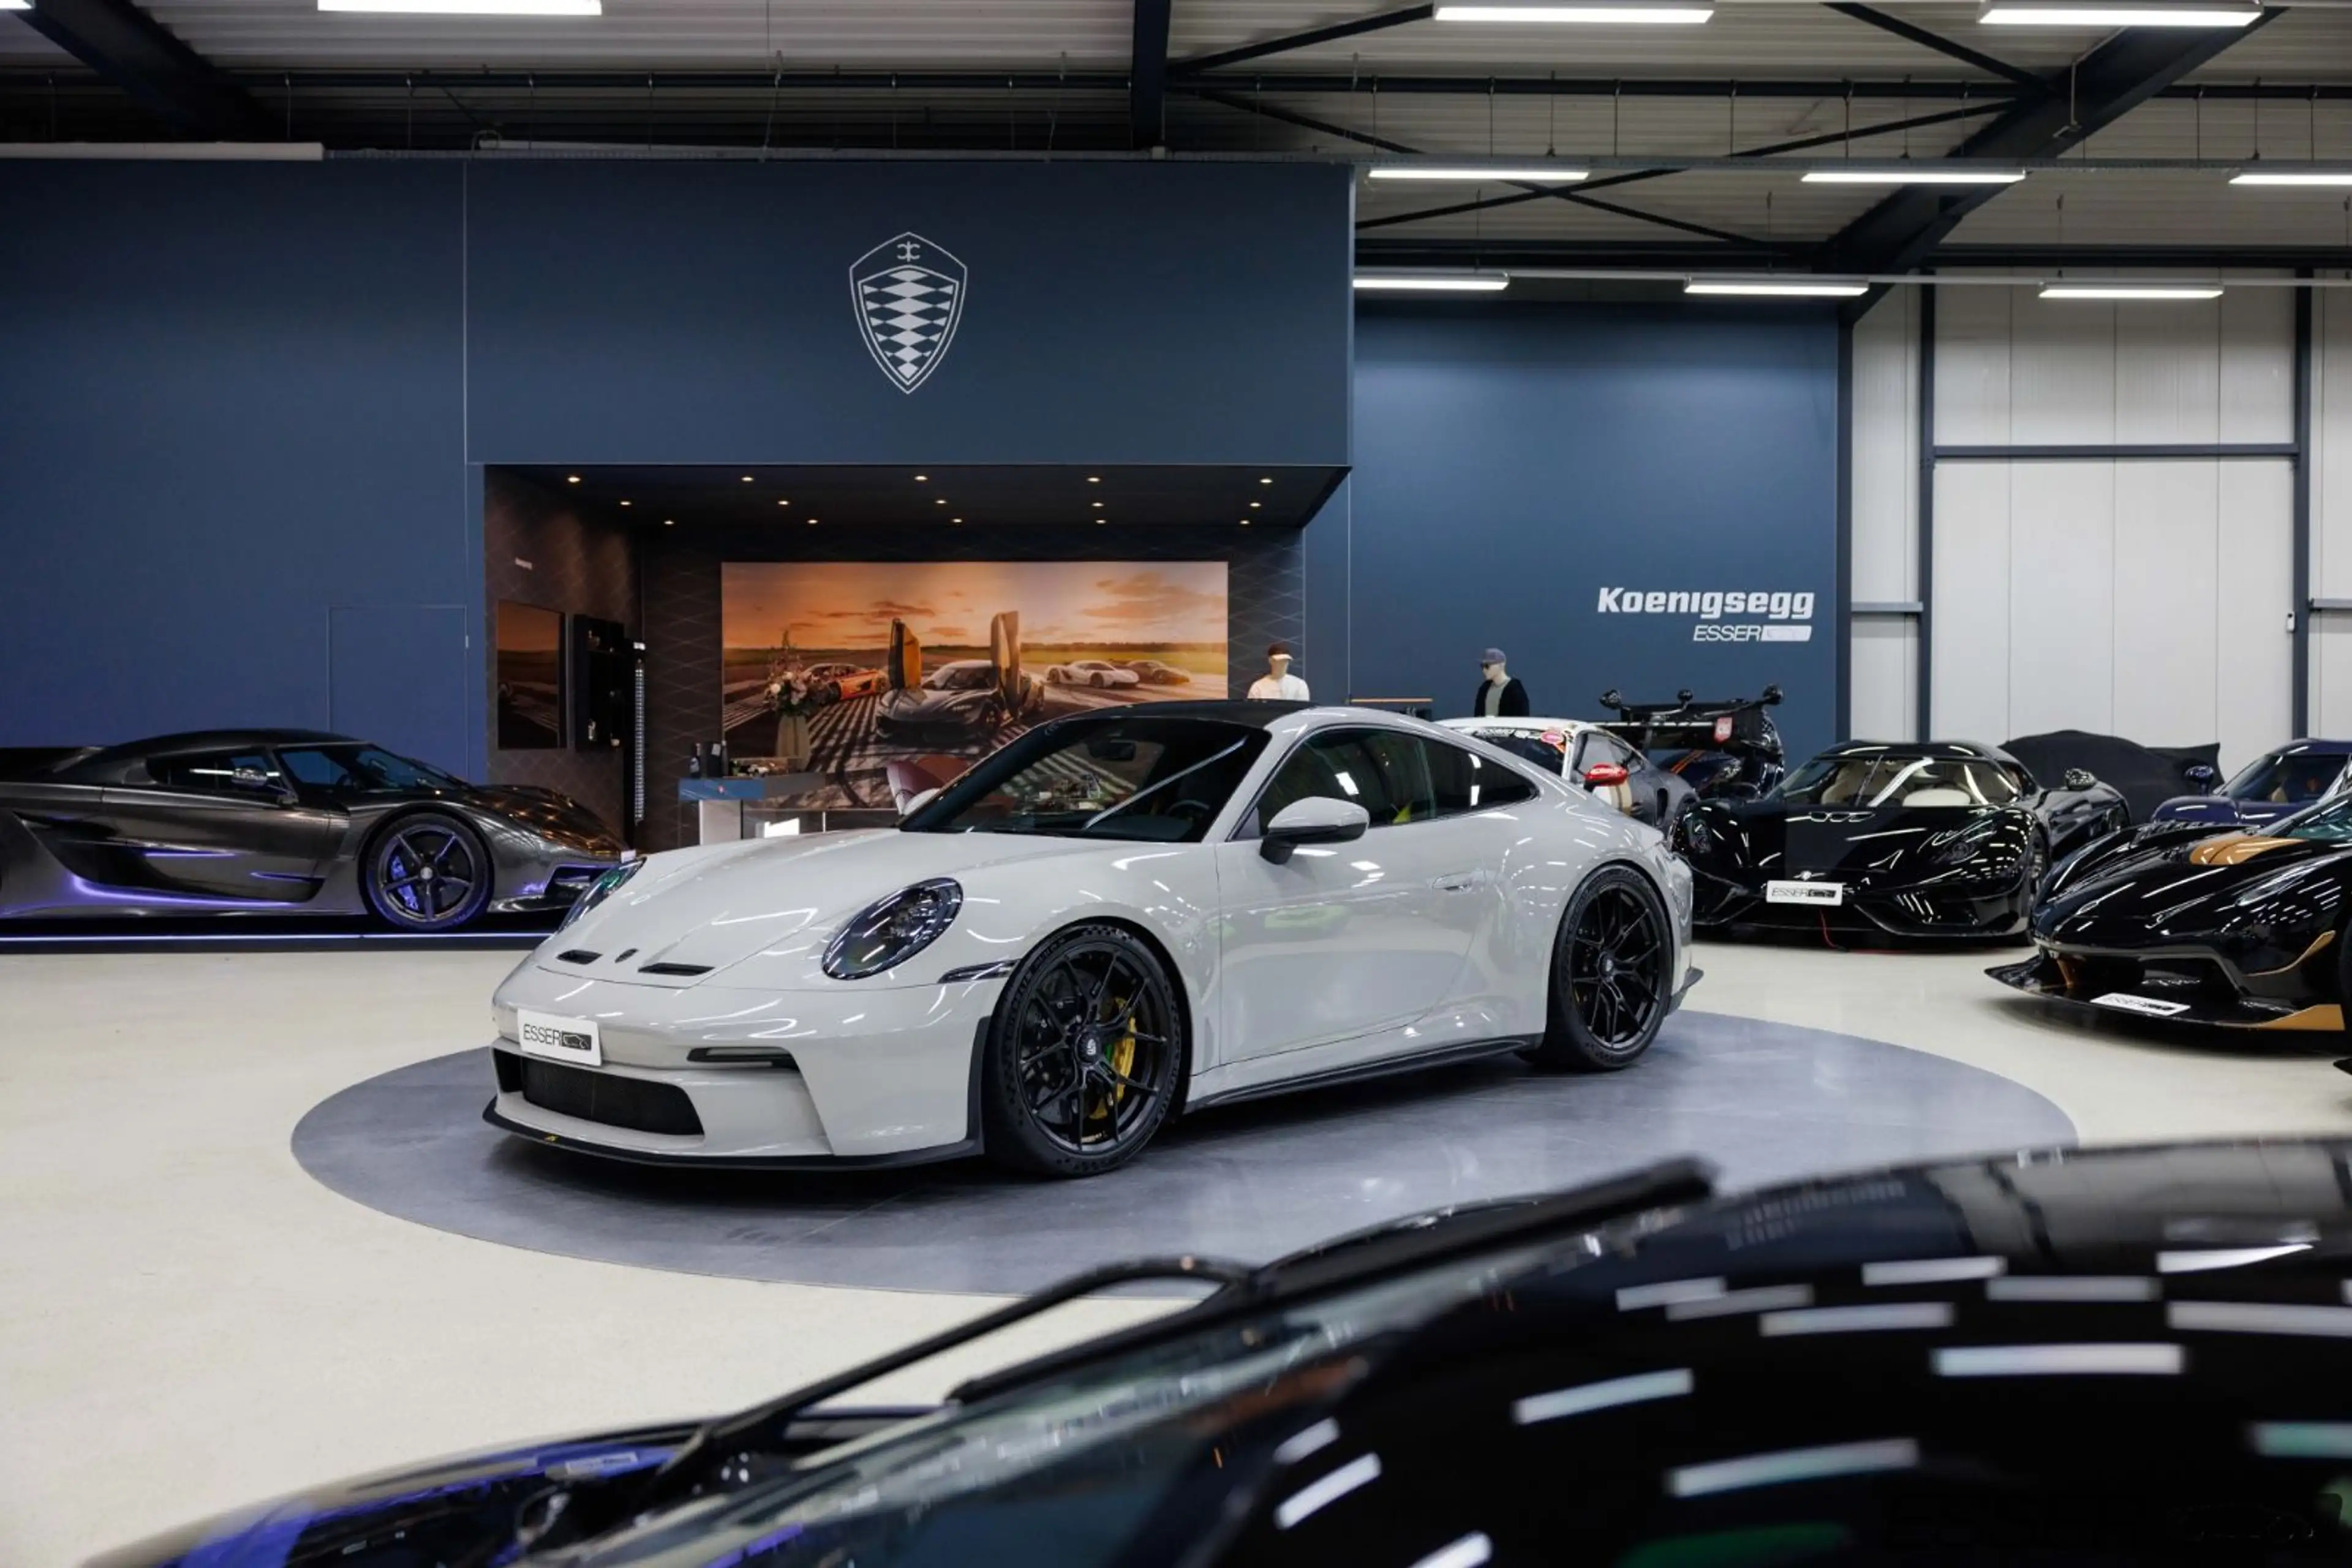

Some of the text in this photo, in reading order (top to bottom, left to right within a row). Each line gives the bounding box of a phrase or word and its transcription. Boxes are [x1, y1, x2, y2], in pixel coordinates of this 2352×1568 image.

[1598, 587, 1814, 619] Koenigsegg
[1693, 625, 1762, 641] ESSER
[524, 1023, 562, 1047] ESSER
